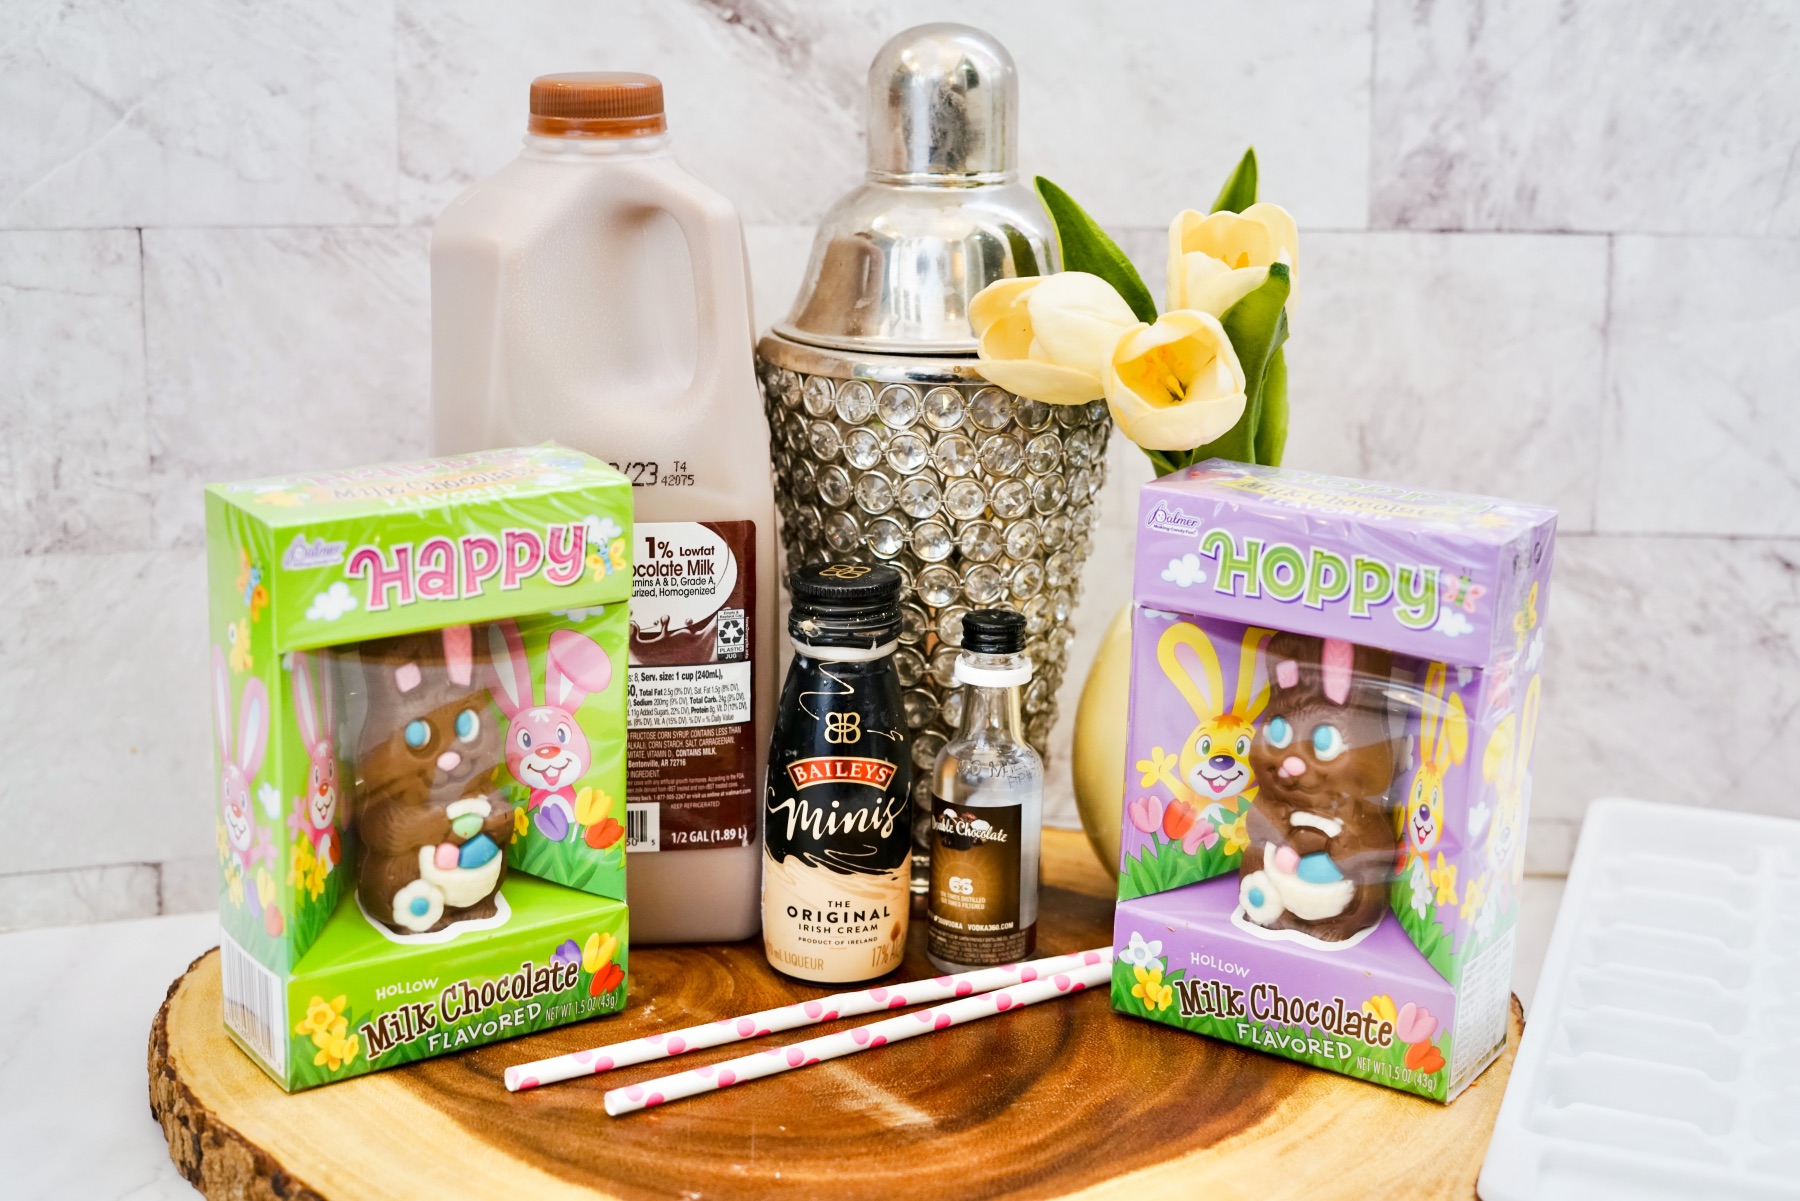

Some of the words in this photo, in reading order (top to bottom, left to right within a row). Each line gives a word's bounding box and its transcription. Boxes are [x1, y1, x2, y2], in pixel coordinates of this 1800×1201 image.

[673, 461, 687, 472] T4
[661, 475, 695, 486] 42075
[645, 537, 674, 558] 1%
[679, 546, 715, 557] Lowfat
[348, 522, 589, 611] Happy
[687, 559, 715, 576] Milk
[655, 578, 661, 587] A
[663, 577, 669, 587] &
[671, 577, 679, 587] D,
[680, 577, 706, 586] Grade
[708, 576, 716, 586] A,
[659, 586, 716, 598] Homogenized
[640, 672, 658, 681] Serv.
[659, 671, 675, 681] size:
[681, 671, 694, 681] cup
[639, 687, 653, 697] Total
[654, 687, 663, 696] Fat
[633, 698, 653, 707] Sodium
[689, 696, 703, 705] Total
[690, 706, 709, 714] Protein
[630, 731, 656, 740] FRUCTOSE
[657, 730, 672, 739] CORN
[691, 728, 715, 738] CONTAINS
[716, 727, 728, 736] LESS
[729, 726, 742, 734] THAN
[648, 740, 663, 749] CORN
[647, 750, 668, 759] VITAMIN
[675, 748, 702, 758] CONTAINS
[661, 759, 669, 767] AR
[669, 758, 687, 767] 72716
[793, 761, 890, 783] BAILEYS
[683, 800, 721, 809] REFRIGERATED
[671, 831, 688, 844] 1/2
[689, 830, 709, 843] GAL
[711, 829, 737, 843] (1.89
[955, 820, 1008, 843] Chocolate
[828, 900, 851, 908] THE
[961, 901, 986, 910] FILTERED
[787, 905, 891, 924] ORIGINAL
[798, 923, 831, 934] IRISH
[837, 923, 879, 934] CREAM
[967, 921, 1014, 932] VODKA360.COM
[798, 936, 832, 946] PRODUCT
[847, 936, 878, 945] IRELAND
[784, 950, 825, 971] LIQUEUR
[1190, 952, 1250, 978] HOLLOW
[375, 976, 439, 1001] HOLLOW
[361, 1002, 436, 1058] Milk
[441, 961, 580, 1025] Chocolate
[545, 1007, 559, 1022] NET
[560, 1004, 573, 1018] WT
[574, 1001, 587, 1015] 1.5
[1175, 980, 1245, 1018] Milk
[1250, 983, 1393, 1048] Chocolate
[428, 1002, 541, 1053] FLAVORED
[1237, 1022, 1353, 1060] FLAVORED
[1356, 1056, 1371, 1072] NET
[1373, 1059, 1386, 1076] WT
[1388, 1063, 1402, 1080] 1.5
[1402, 1068, 1412, 1084] OZ
[1413, 1072, 1438, 1092] (43g)
